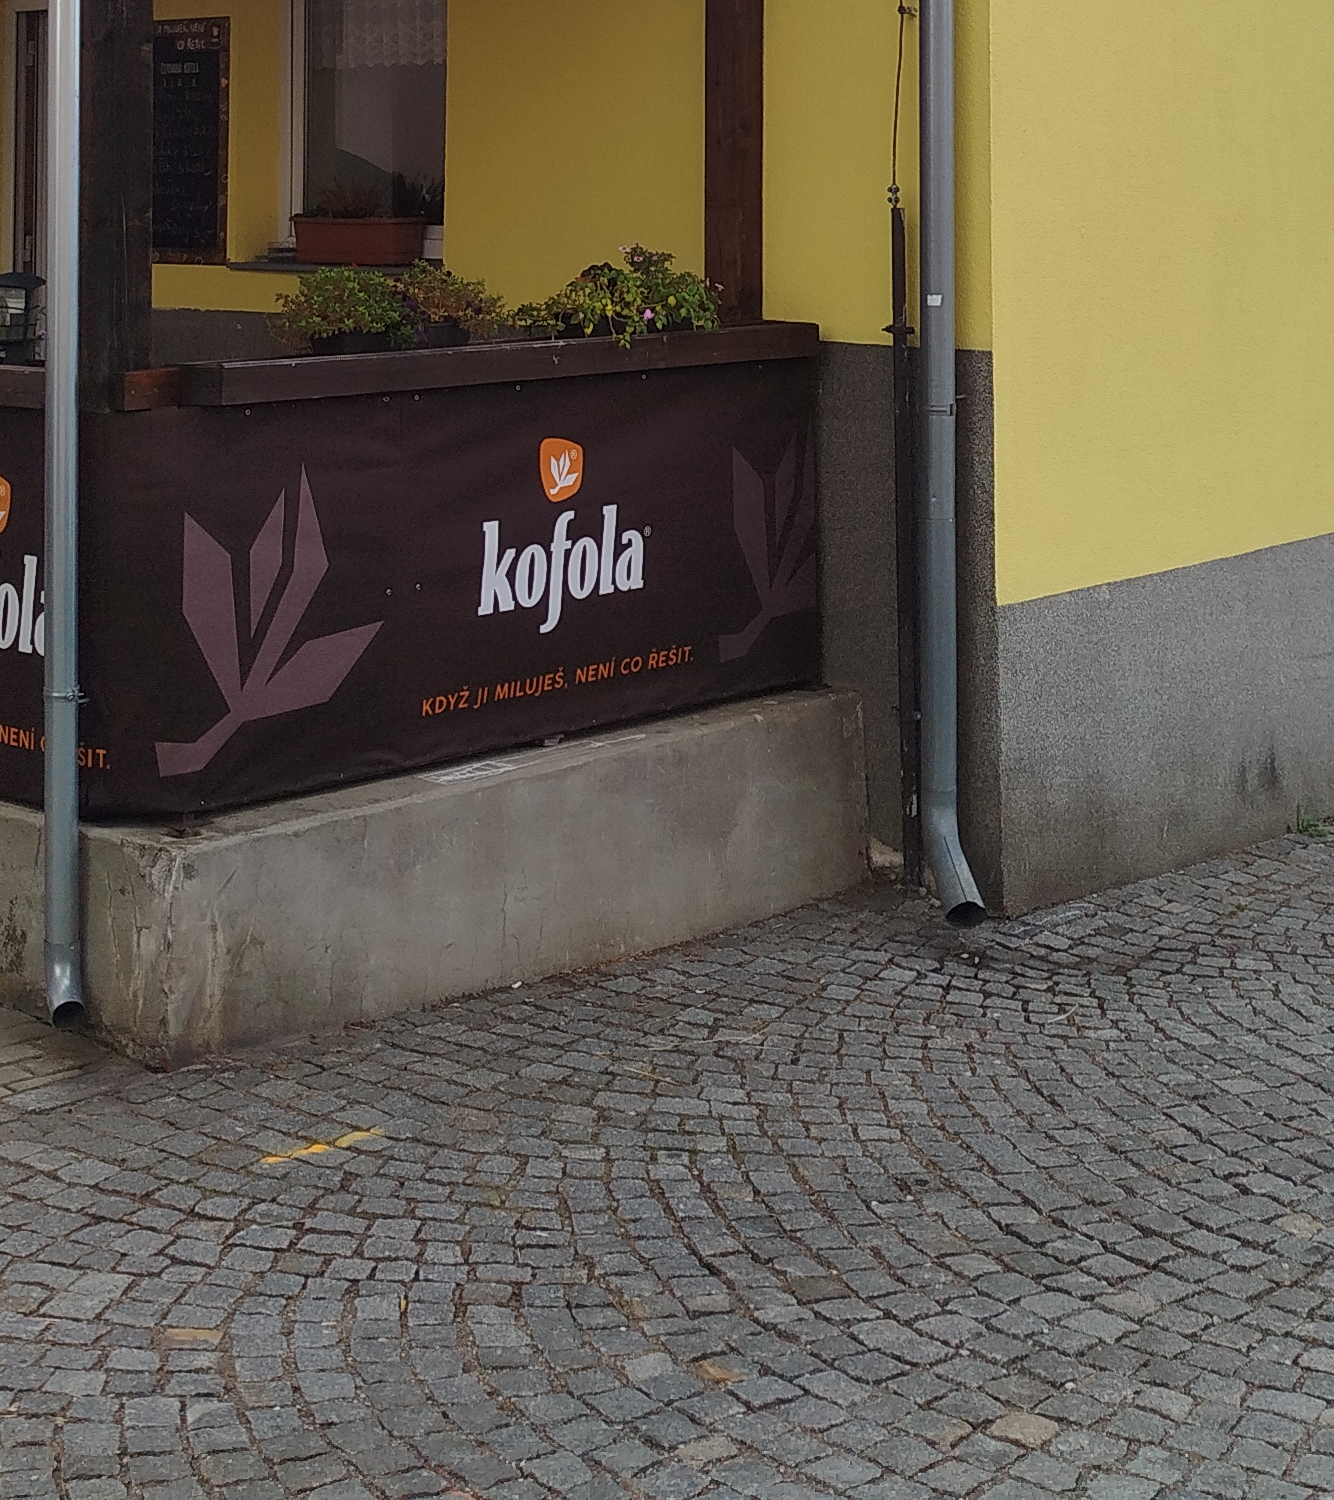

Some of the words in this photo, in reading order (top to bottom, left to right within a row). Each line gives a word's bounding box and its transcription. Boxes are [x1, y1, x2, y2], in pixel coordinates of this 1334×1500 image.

[478, 504, 644, 634] kofola
[421, 686, 471, 717] KDYŽ
[473, 686, 489, 710] JI
[494, 666, 569, 702] MILUJEŠ,
[575, 657, 616, 685] NENÍ
[619, 655, 643, 675] CO
[647, 644, 694, 671] ŘEŠIT.
